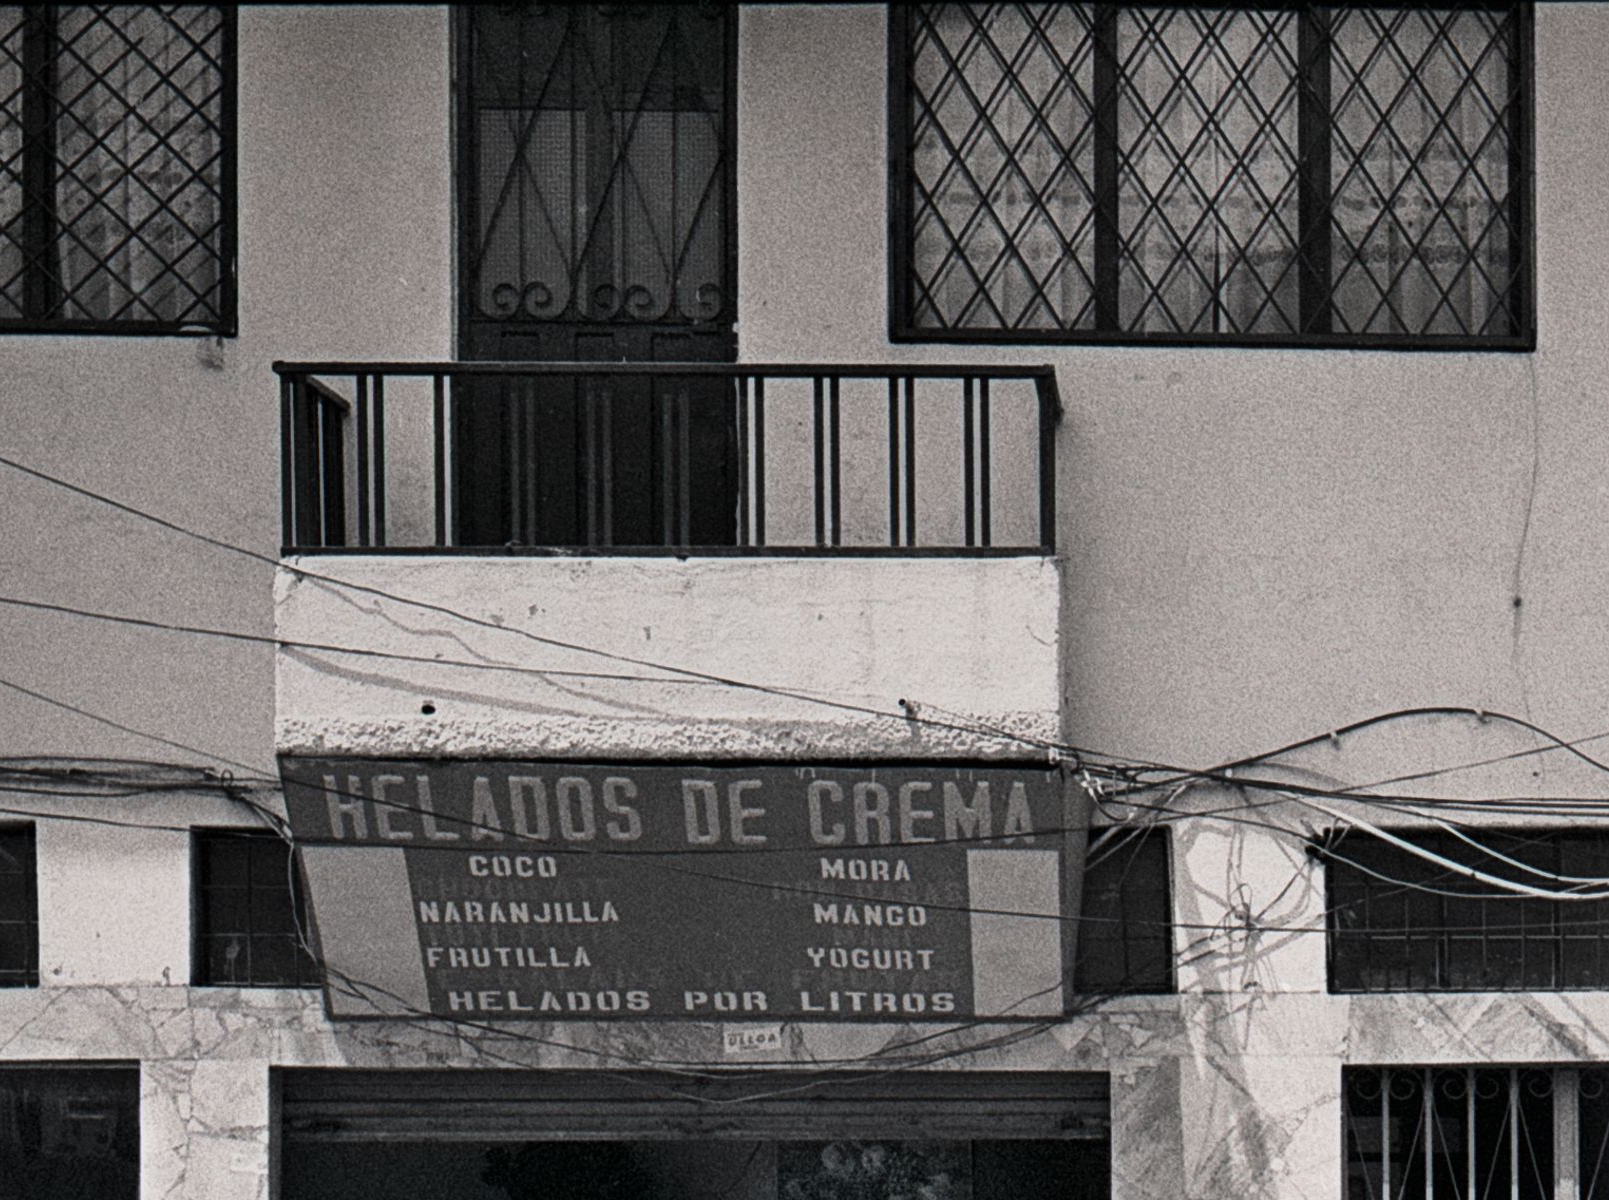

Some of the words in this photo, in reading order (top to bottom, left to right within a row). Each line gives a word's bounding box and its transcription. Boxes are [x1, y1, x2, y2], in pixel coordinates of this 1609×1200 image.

[323, 774, 643, 842] HELADOS
[681, 778, 767, 846] DE
[807, 777, 1038, 847] CREMA
[468, 855, 558, 878] COCO
[819, 857, 911, 882] MORA
[418, 900, 620, 923] NARANJILLA
[812, 902, 928, 927] MANGO
[425, 946, 592, 968] FRUTILLA
[806, 947, 935, 971] YOGURT
[447, 989, 651, 1012] HELADOS
[683, 990, 768, 1012] POR
[800, 990, 957, 1014] LITROS
